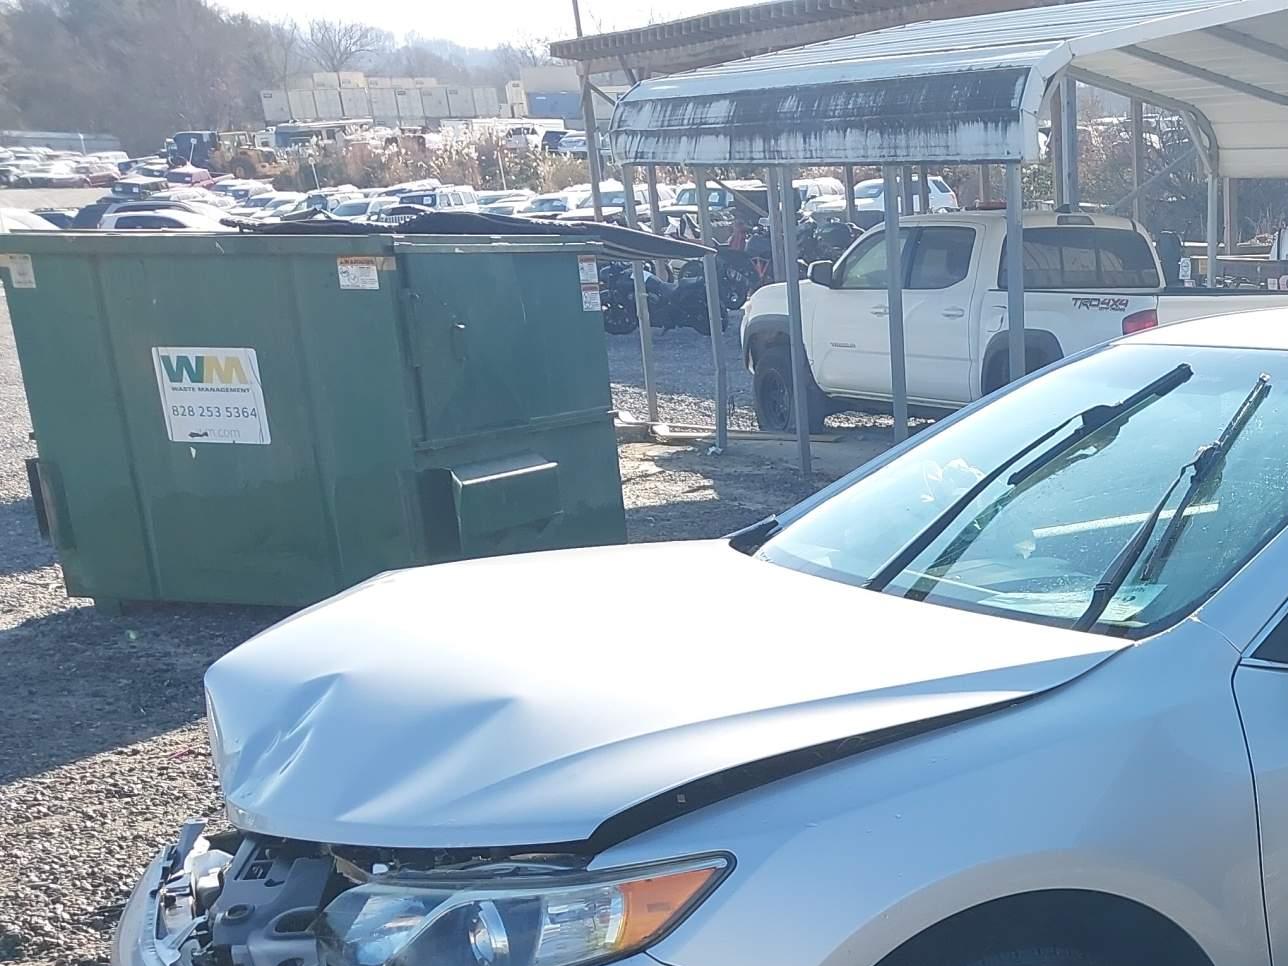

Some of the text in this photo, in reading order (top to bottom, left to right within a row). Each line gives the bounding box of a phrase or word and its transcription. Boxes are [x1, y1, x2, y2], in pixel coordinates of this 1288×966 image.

[160, 355, 249, 384] WM
[171, 405, 258, 419] 828 253 5364
